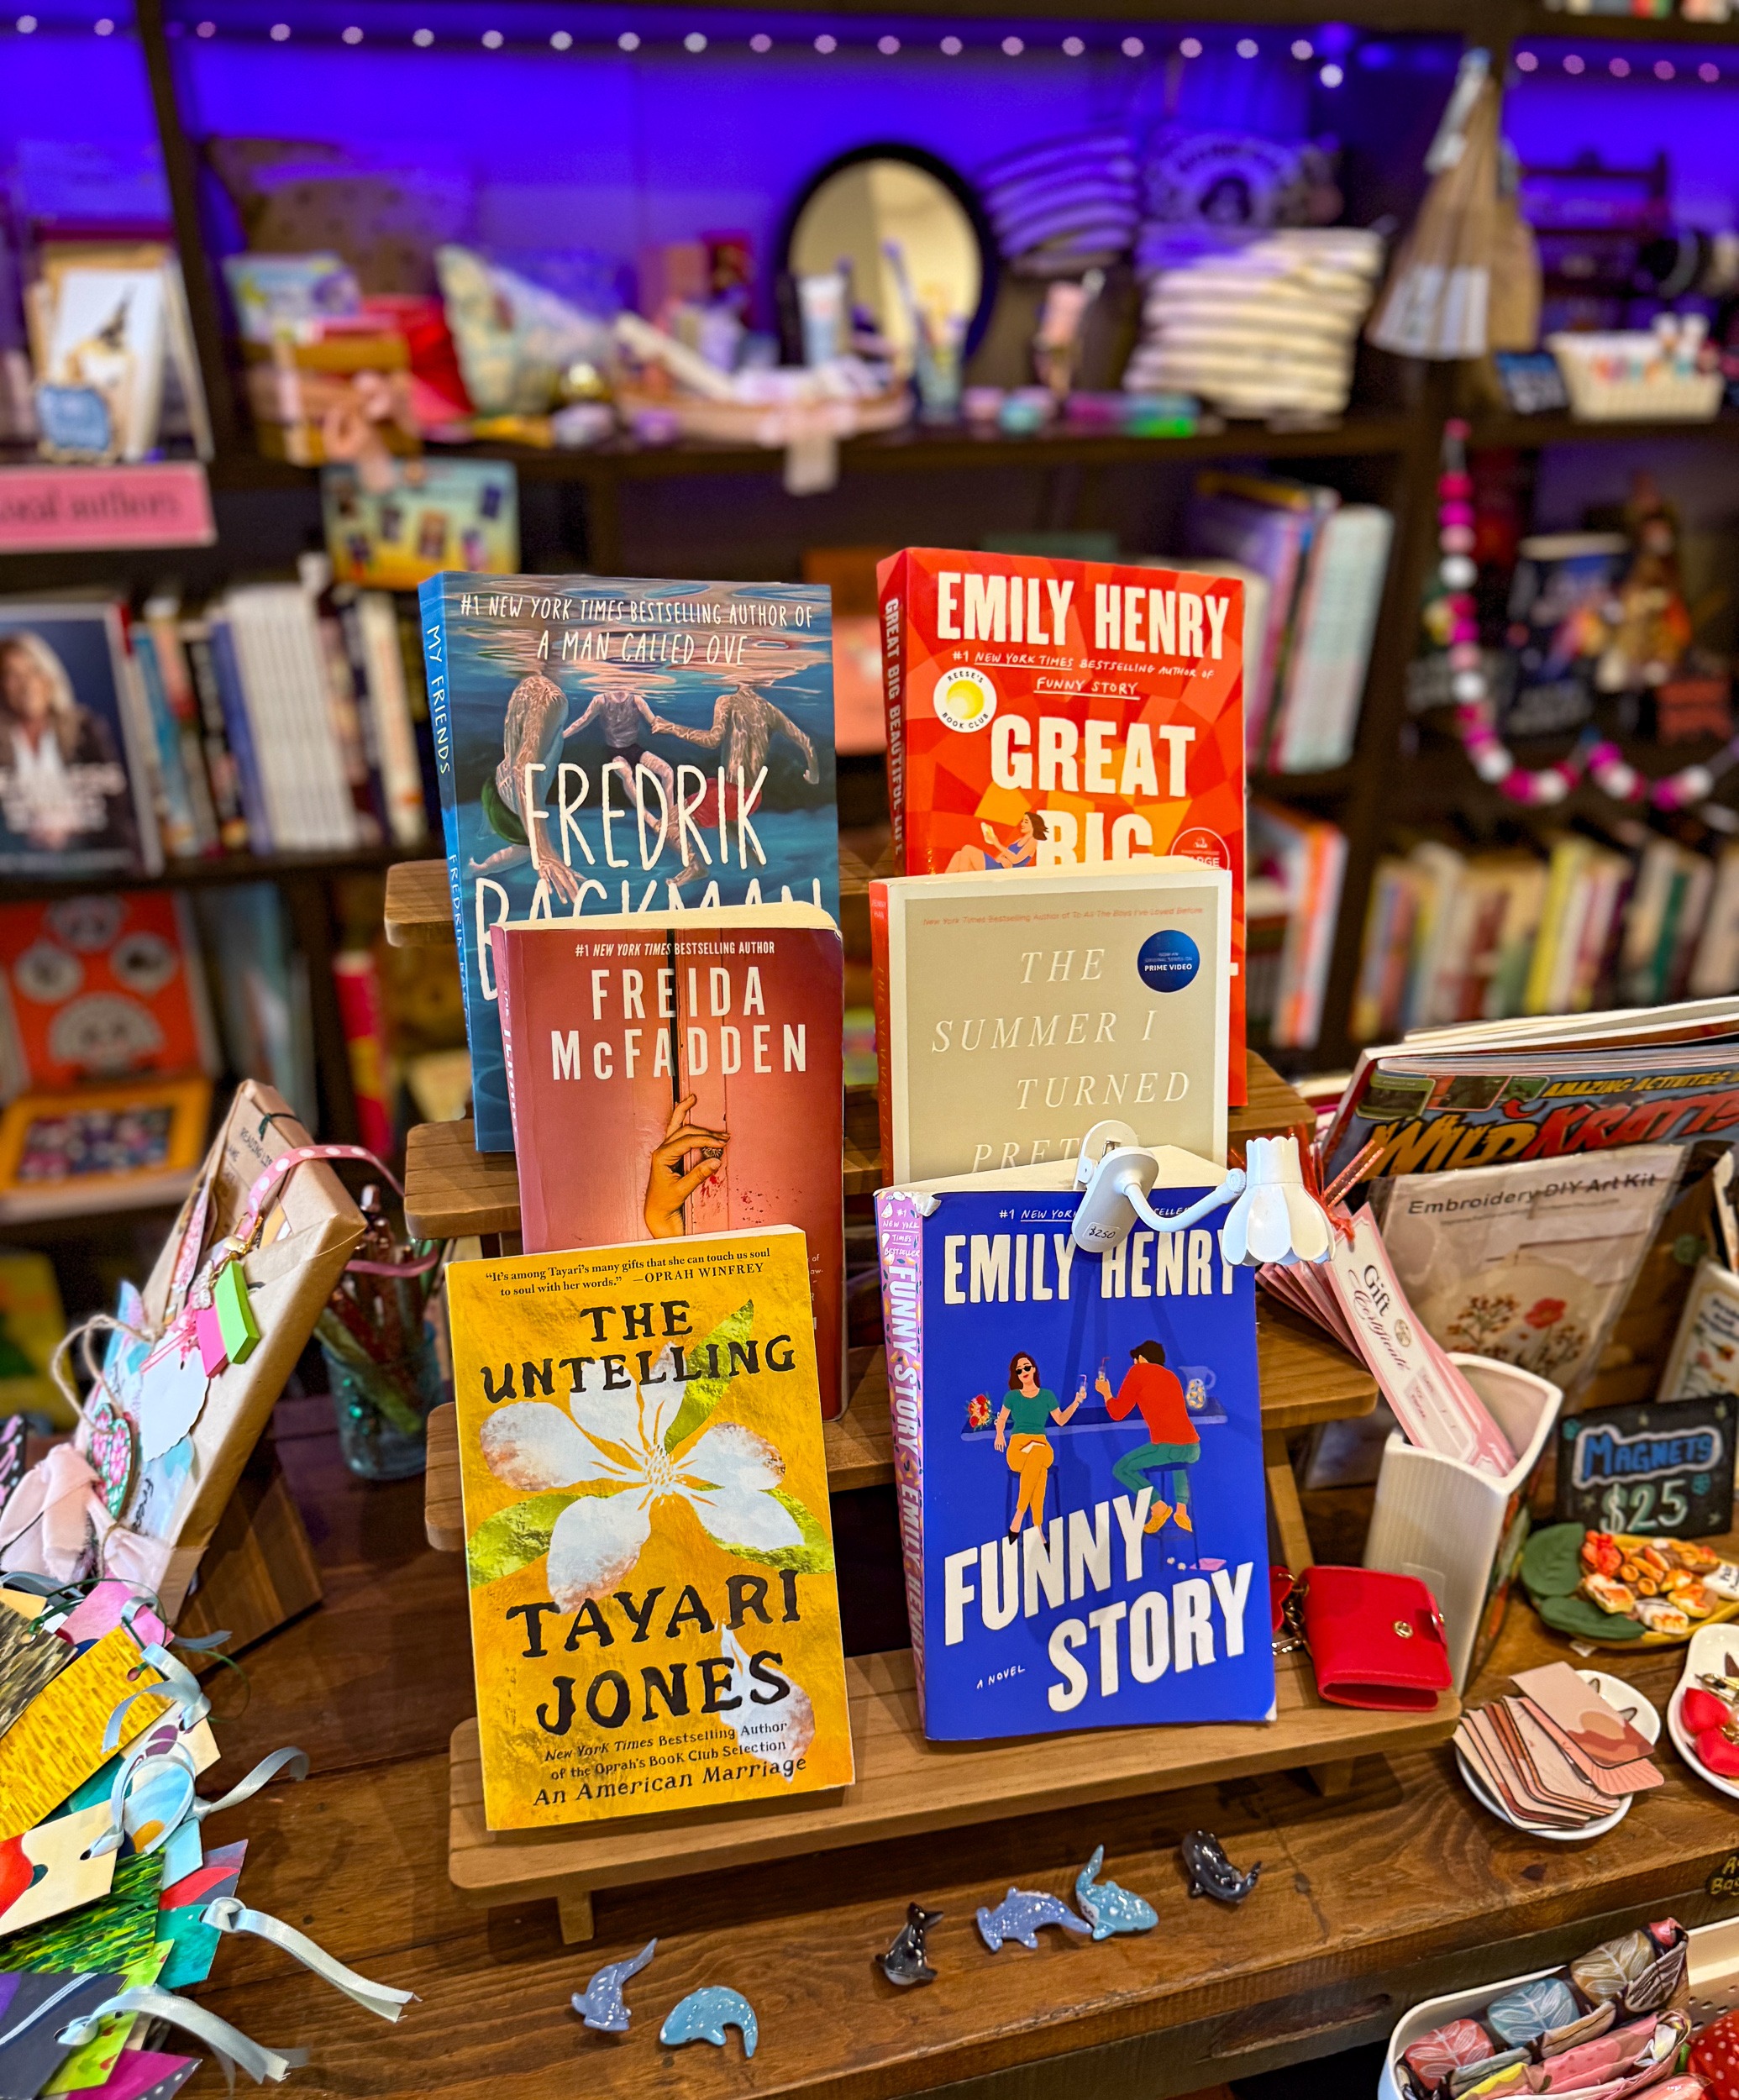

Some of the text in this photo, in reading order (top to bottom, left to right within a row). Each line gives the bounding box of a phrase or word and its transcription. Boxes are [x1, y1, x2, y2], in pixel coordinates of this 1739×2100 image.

[460, 596, 813, 628] #1 NEW YORK TIMES BESTSELLING AUTHOR OF
[885, 597, 900, 657] GREAT
[938, 571, 1230, 659] EMILY HENRY
[537, 630, 749, 666] A MAN CALLED OVE
[952, 650, 1215, 680] #1 NEW YORK TIMES BESTSELLING AUTHOR OF
[427, 624, 450, 774] MY FRIENDS
[887, 664, 901, 700] BIG
[947, 670, 985, 684] REESE'S
[1037, 677, 1138, 696] FUNNY STORY
[942, 711, 990, 729] BOOK CLUB
[889, 705, 904, 807] BEAUTIFUL
[990, 714, 1196, 797] GREAT
[524, 763, 769, 870] FREDRIK
[1036, 810, 1154, 866] BIG
[449, 853, 463, 948] FREDRIK
[575, 941, 775, 957] #1 NEW YORK TIMES BESTSELLING AUTHOR
[1020, 948, 1106, 984] THE
[591, 966, 765, 1021] FREIDA
[551, 1024, 807, 1080] McFADDEN
[932, 1010, 1157, 1053] SUMMER I
[1017, 1071, 1190, 1110] TURNED
[1541, 1078, 1634, 1099] AMAZING
[1631, 1071, 1731, 1092] ACTIVITIES
[972, 1137, 1081, 1173] PRET
[1364, 1089, 1739, 1181] WILD KRATTS
[896, 1209, 908, 1217] #1
[999, 1209, 1015, 1220] #1
[1021, 1208, 1048, 1219] NEW
[1408, 1189, 1537, 1215] Embroidery
[1543, 1180, 1582, 1198] DIY
[1585, 1177, 1619, 1193] Art
[1624, 1173, 1657, 1188] Kit
[511, 1268, 546, 1282] among
[548, 1263, 589, 1279] Tayari’s
[591, 1263, 620, 1276] many
[622, 1257, 644, 1273] gifts
[646, 1257, 666, 1268] that
[668, 1255, 686, 1266] she
[687, 1254, 705, 1264] can
[707, 1250, 734, 1263] touch
[736, 1252, 748, 1260] us
[749, 1247, 770, 1259] soul
[812, 1253, 820, 1262] of
[884, 1247, 920, 1258] BESTSELLER
[943, 1229, 1233, 1304] EMILY HENRY
[500, 1286, 512, 1297] to
[513, 1284, 535, 1295] soul
[537, 1280, 561, 1294] with
[563, 1279, 581, 1291] her
[699, 1263, 764, 1278] WINFREY
[1363, 1264, 1391, 1317] Gift
[580, 1299, 693, 1343] THE
[480, 1334, 796, 1404] UNTELLING
[889, 1266, 918, 1457] FUNNY STORY
[1583, 1433, 1712, 1482] MAGNETS
[901, 1483, 921, 1574] EMILY
[1600, 1480, 1688, 1535] $25
[944, 1486, 1153, 1646] FUNNY
[506, 1569, 801, 1658] TAYARI
[1048, 1562, 1253, 1713] STORY
[536, 1650, 791, 1735] JONES
[976, 1665, 1025, 1689] A NOVEL
[545, 1748, 573, 1762] New
[614, 1737, 654, 1752] Times
[659, 1727, 736, 1747] Bestselling
[740, 1722, 788, 1737] Author
[550, 1767, 566, 1781] of
[570, 1764, 591, 1778] the
[595, 1757, 646, 1777] Oprah's
[688, 1747, 719, 1763] Club
[722, 1739, 786, 1757] Selection
[533, 1757, 807, 1807] An American Marriage
